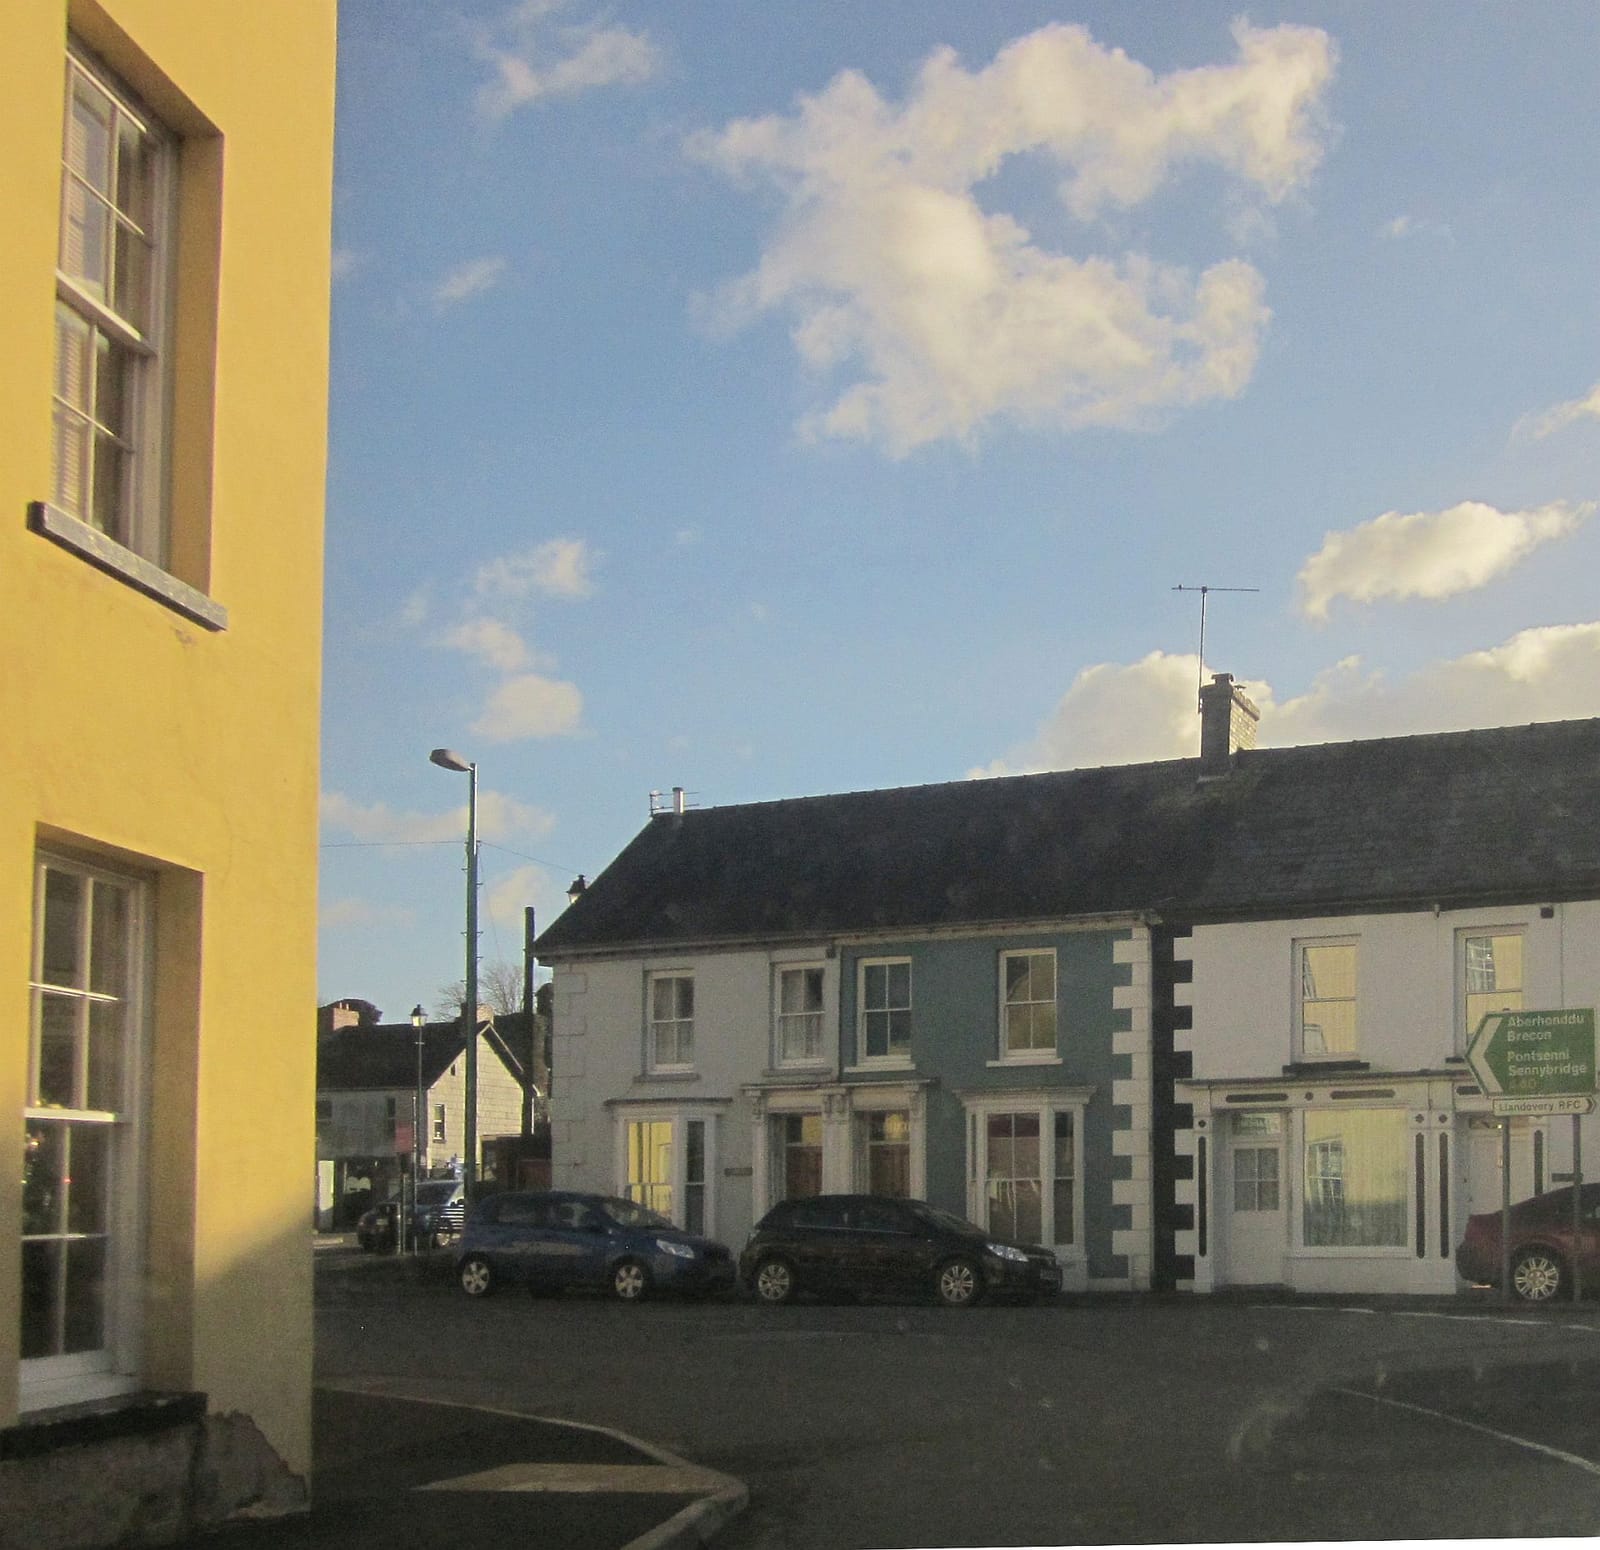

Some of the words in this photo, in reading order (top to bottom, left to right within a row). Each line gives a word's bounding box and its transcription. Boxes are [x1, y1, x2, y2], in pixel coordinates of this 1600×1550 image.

[1507, 1014, 1585, 1027] Aberhonddu
[1507, 1030, 1552, 1042] Brecon
[1507, 1049, 1570, 1062] Pontsenni
[1508, 1063, 1587, 1077] Sennybridge
[1499, 1102, 1554, 1113] Llandovery
[1559, 1100, 1581, 1109] RFC
